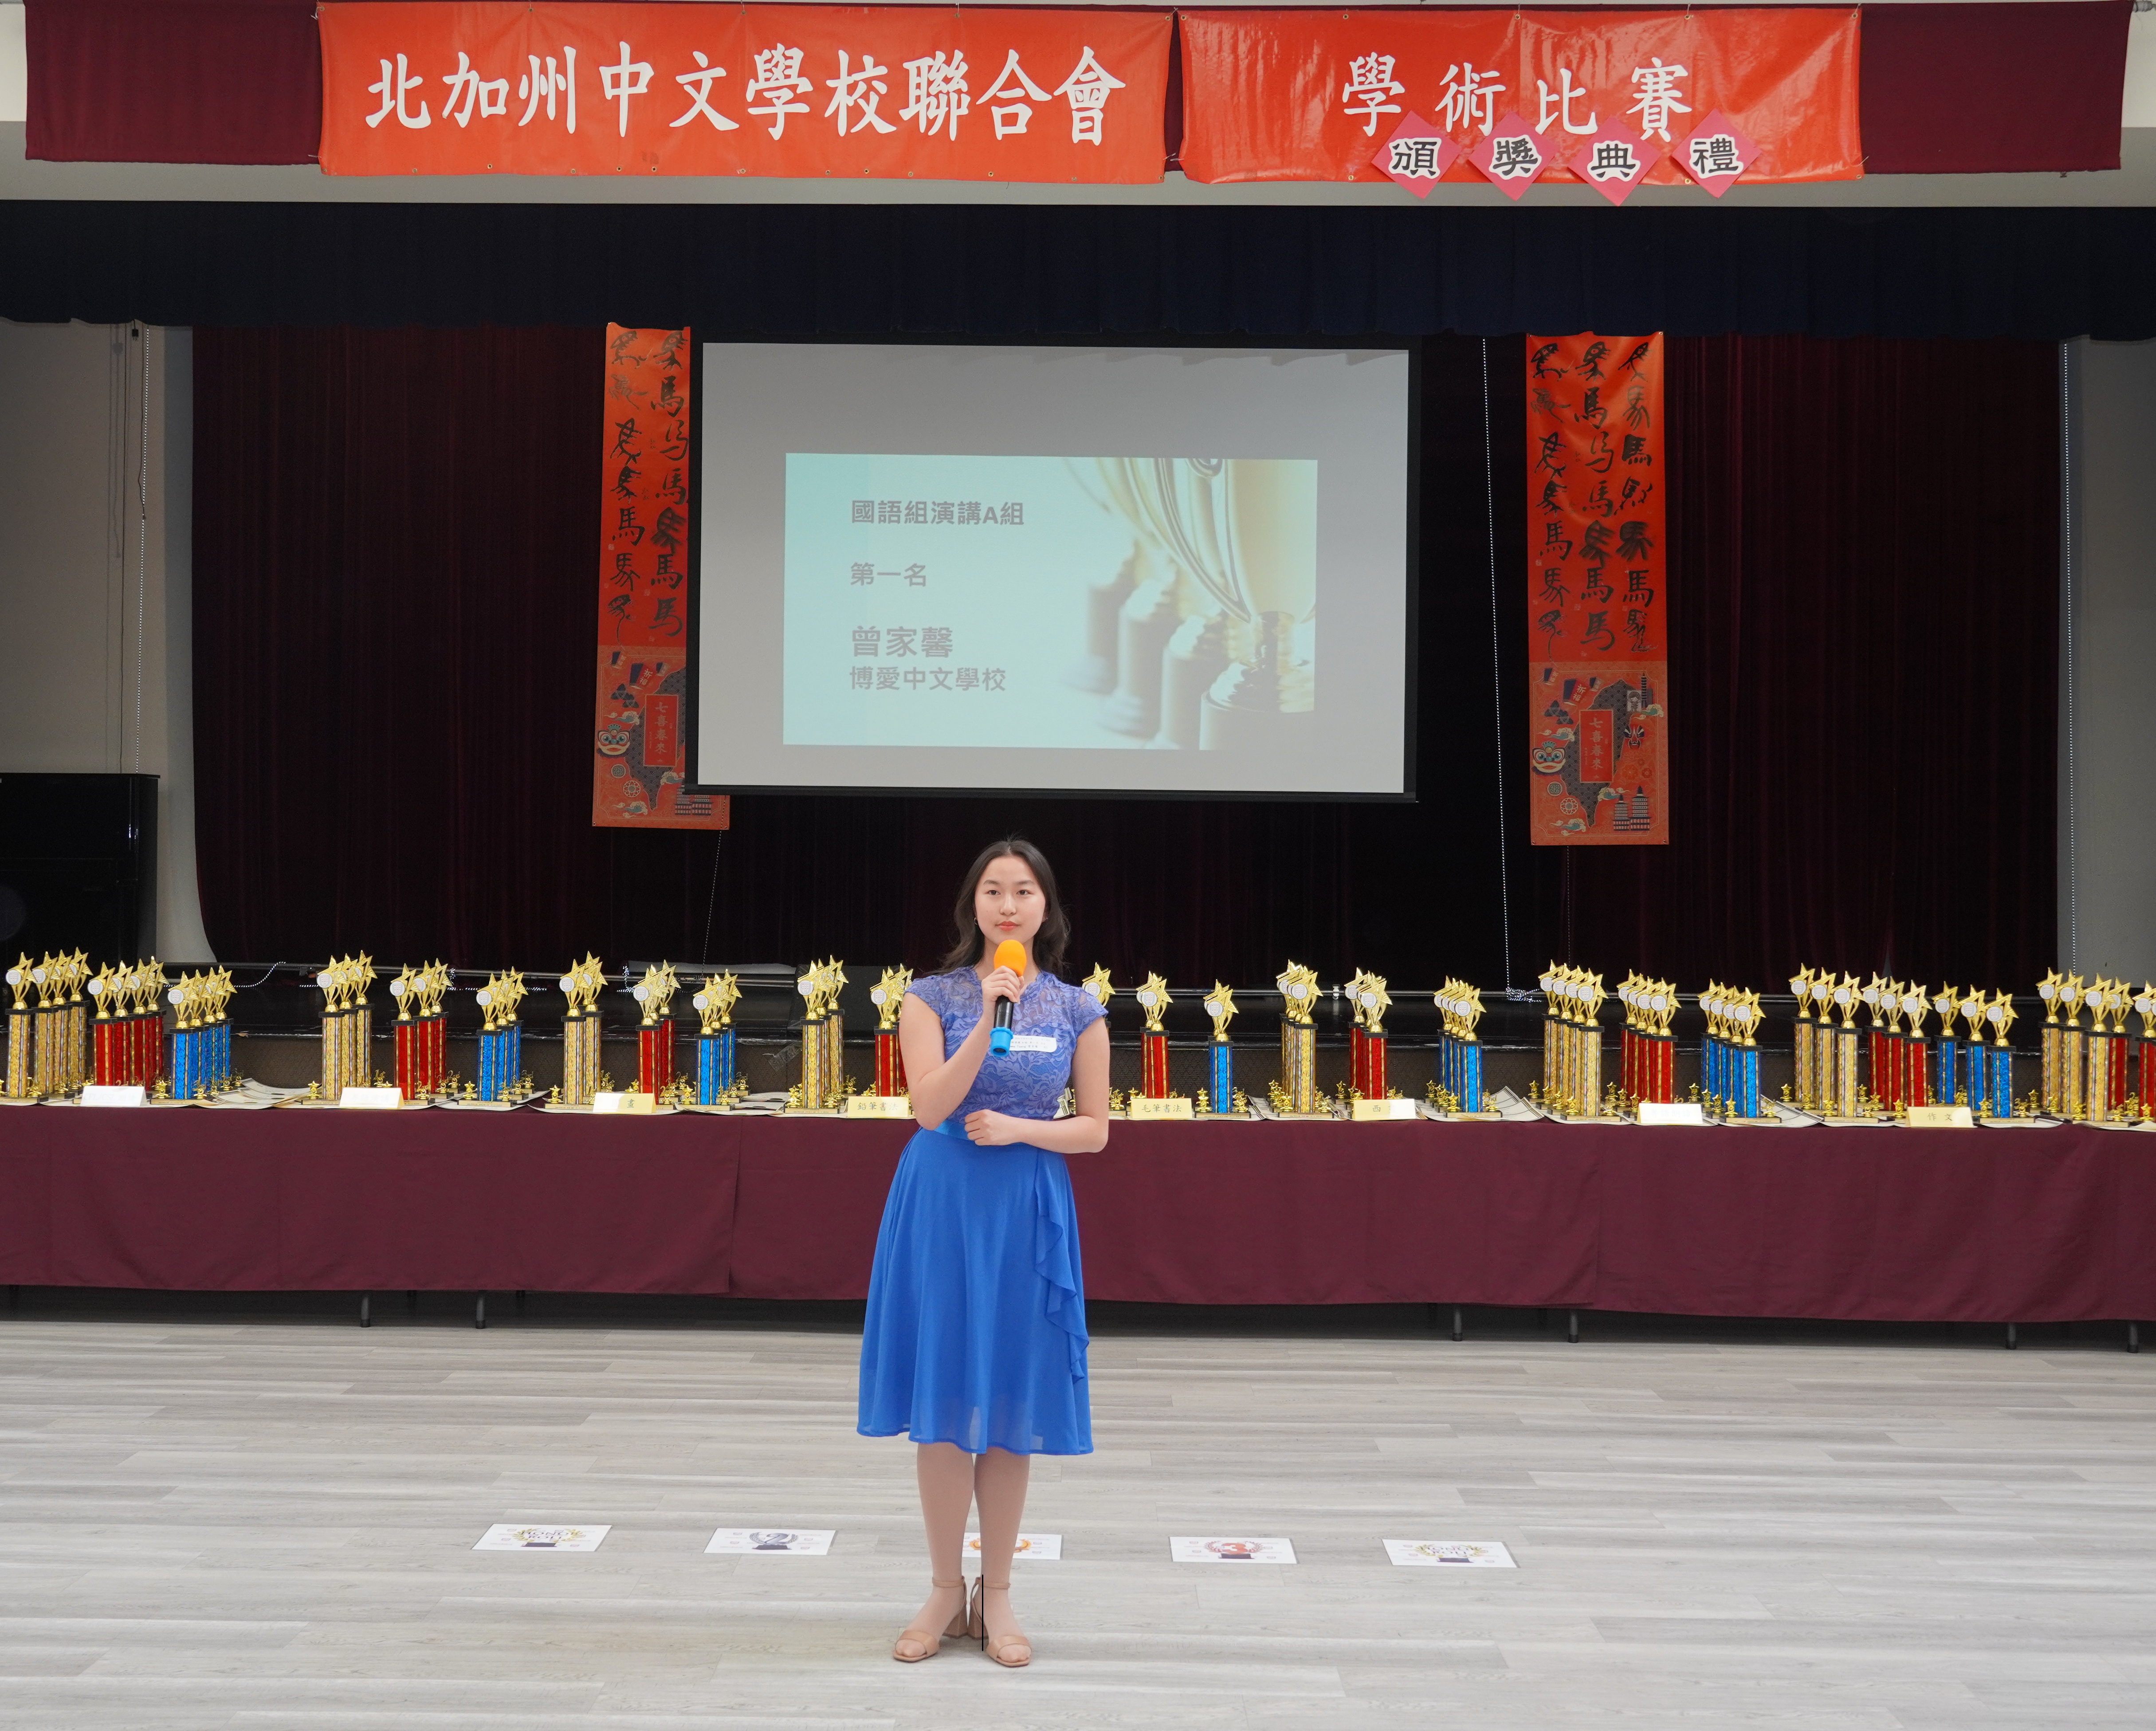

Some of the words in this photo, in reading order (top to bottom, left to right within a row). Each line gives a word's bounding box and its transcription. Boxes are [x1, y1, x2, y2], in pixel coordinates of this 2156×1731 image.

[366, 41, 1127, 146] 北加州中文學校聯合會
[1343, 51, 1693, 143] 學術比賽
[1388, 137, 1740, 178] 頒獎典禮
[851, 500, 1024, 525] 國語組演講A組
[850, 562, 927, 587] 第一名
[851, 626, 954, 658] 曾家馨
[639, 669, 653, 686] 祈福
[849, 666, 1006, 691] 博愛中文學校
[1573, 684, 1587, 701] 祈福
[1142, 1104, 1182, 1113] 毛筆書法
[764, 1533, 789, 1544] 2
[1221, 1542, 1248, 1554] 3
